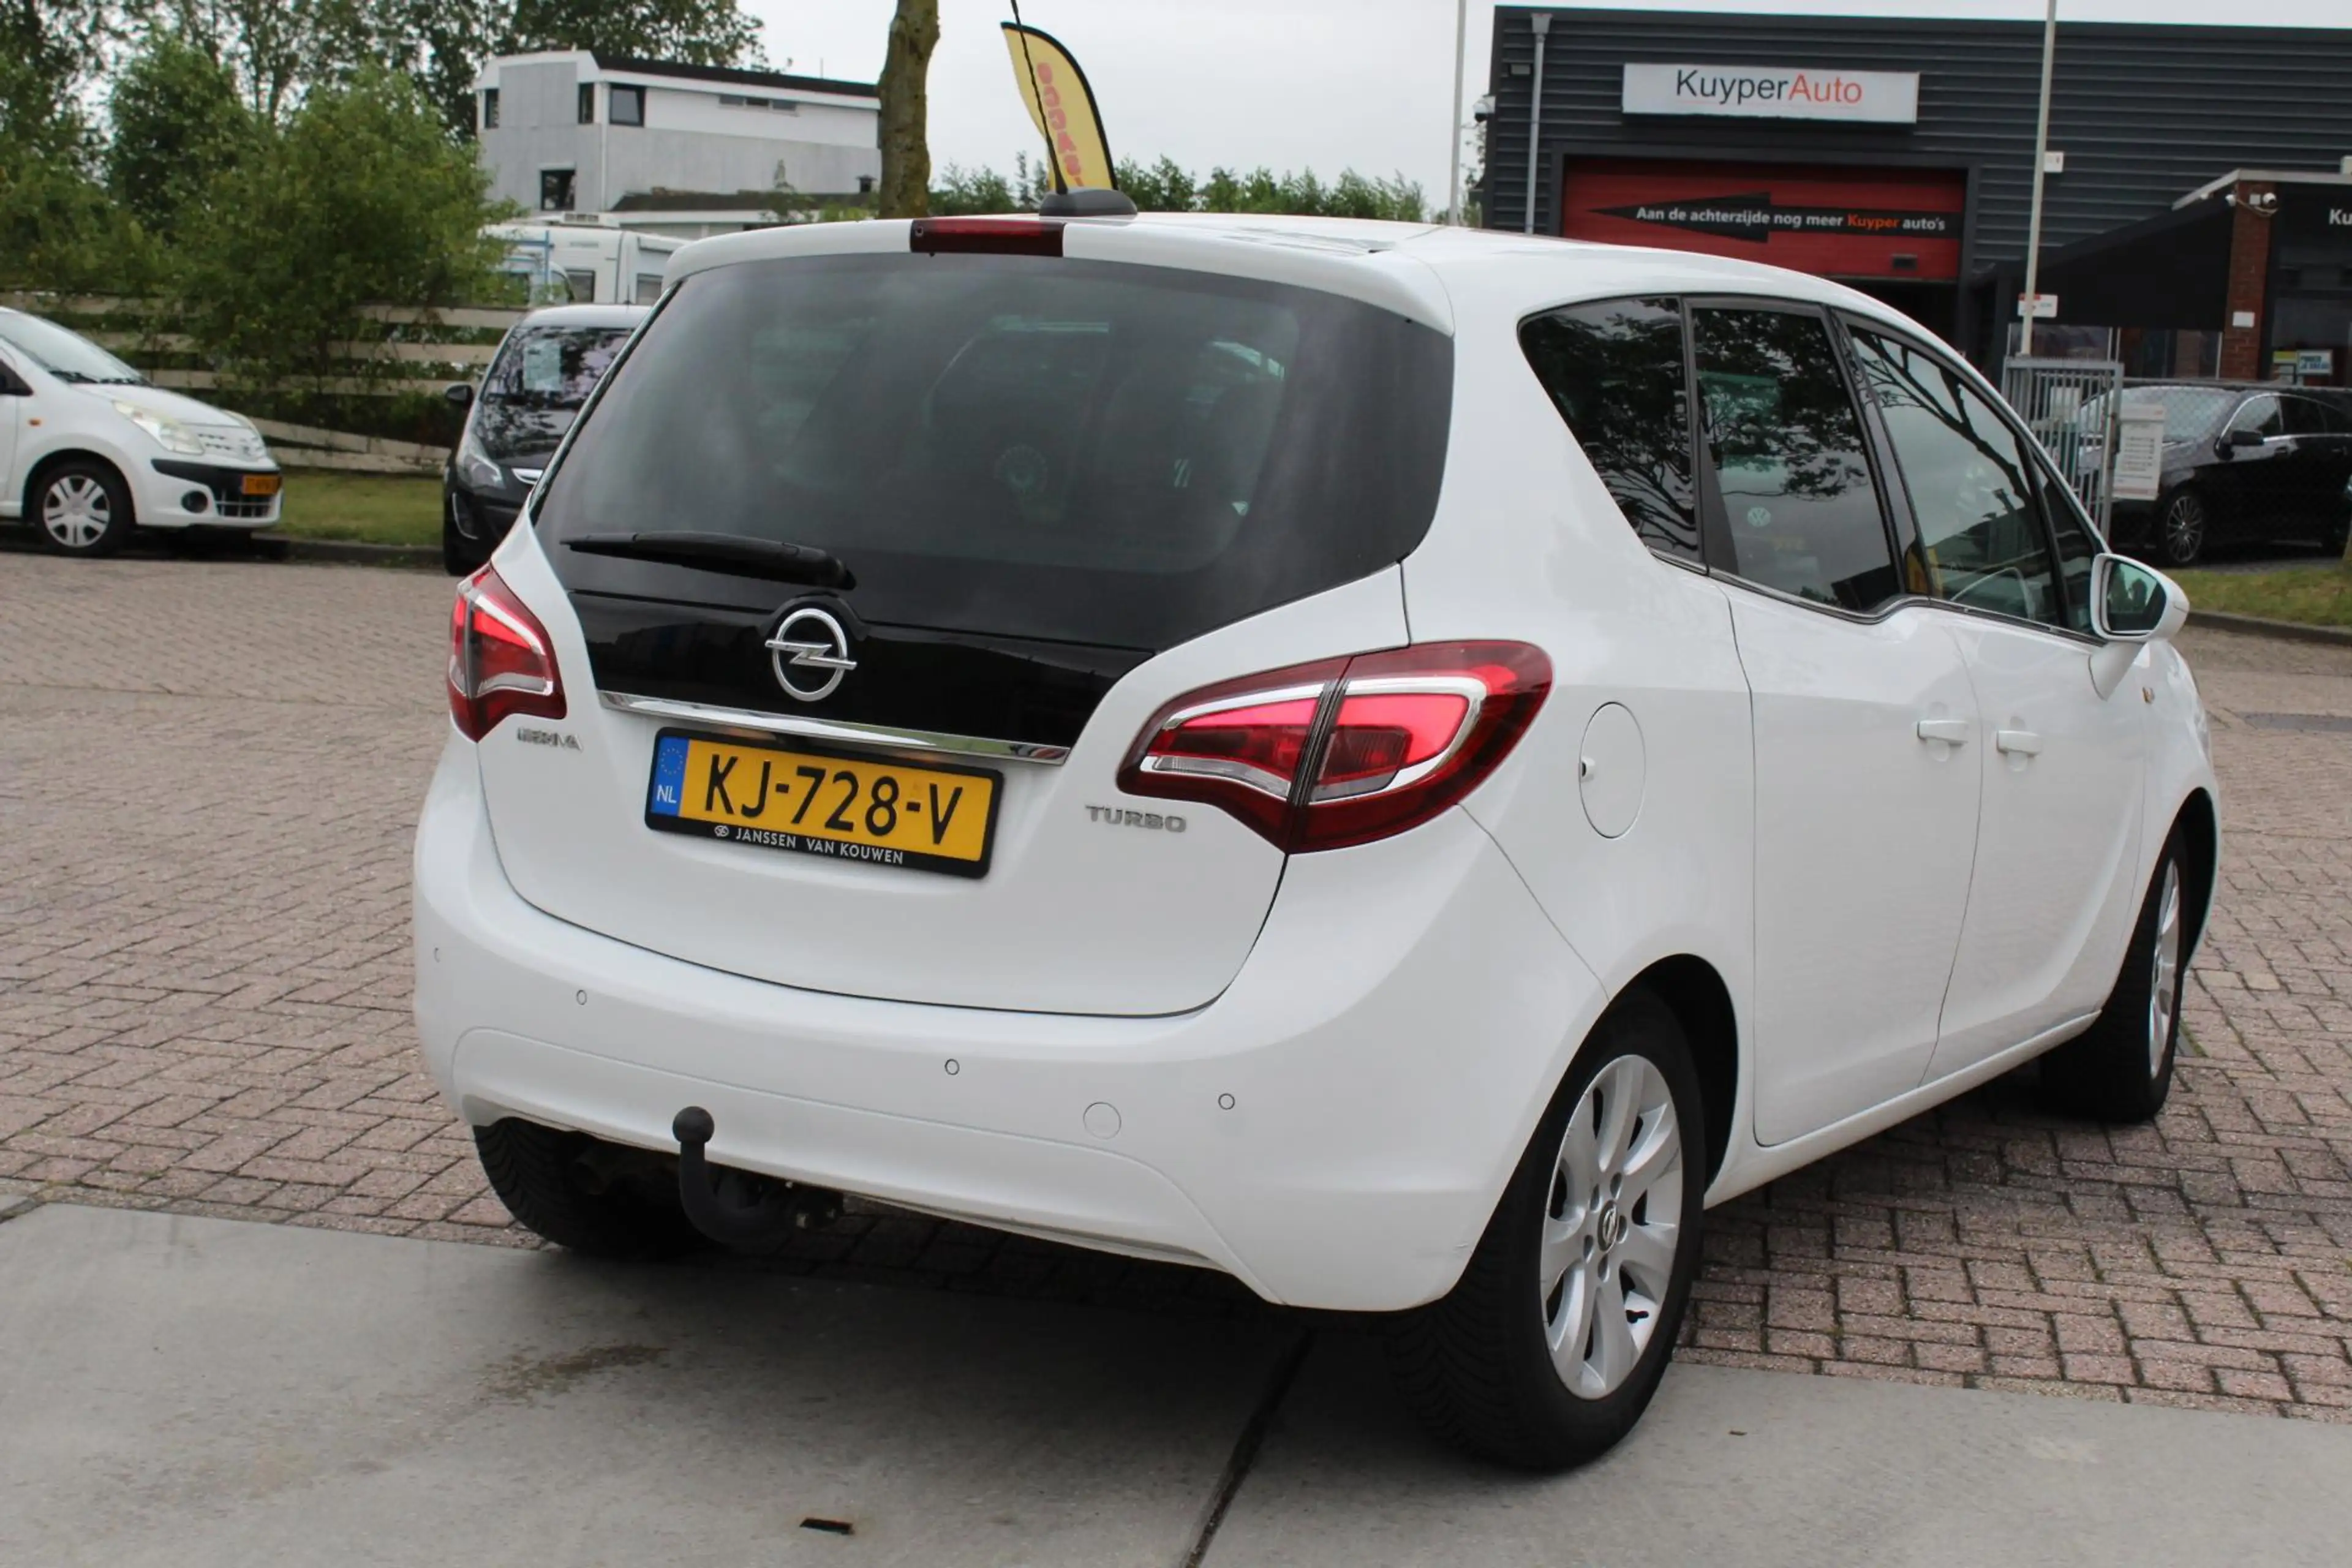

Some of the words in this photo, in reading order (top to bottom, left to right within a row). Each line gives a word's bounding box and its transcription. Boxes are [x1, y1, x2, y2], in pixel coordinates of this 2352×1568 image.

[1676, 69, 1863, 105] KuyperAuto
[1637, 207, 1664, 220] Aan
[1668, 208, 1687, 221] de
[1690, 209, 1770, 226] achterzijde
[1774, 213, 1801, 227] nog
[1806, 214, 1844, 227] meer
[1847, 214, 1899, 229] Kuyper
[1903, 217, 1946, 230] auto's
[655, 784, 677, 804] NL
[705, 753, 964, 845] KJ-728-V
[1085, 805, 1187, 833] TURBO
[736, 827, 796, 849] JANSSEN
[806, 838, 835, 854] VAN
[840, 842, 904, 865] KOUWEN
